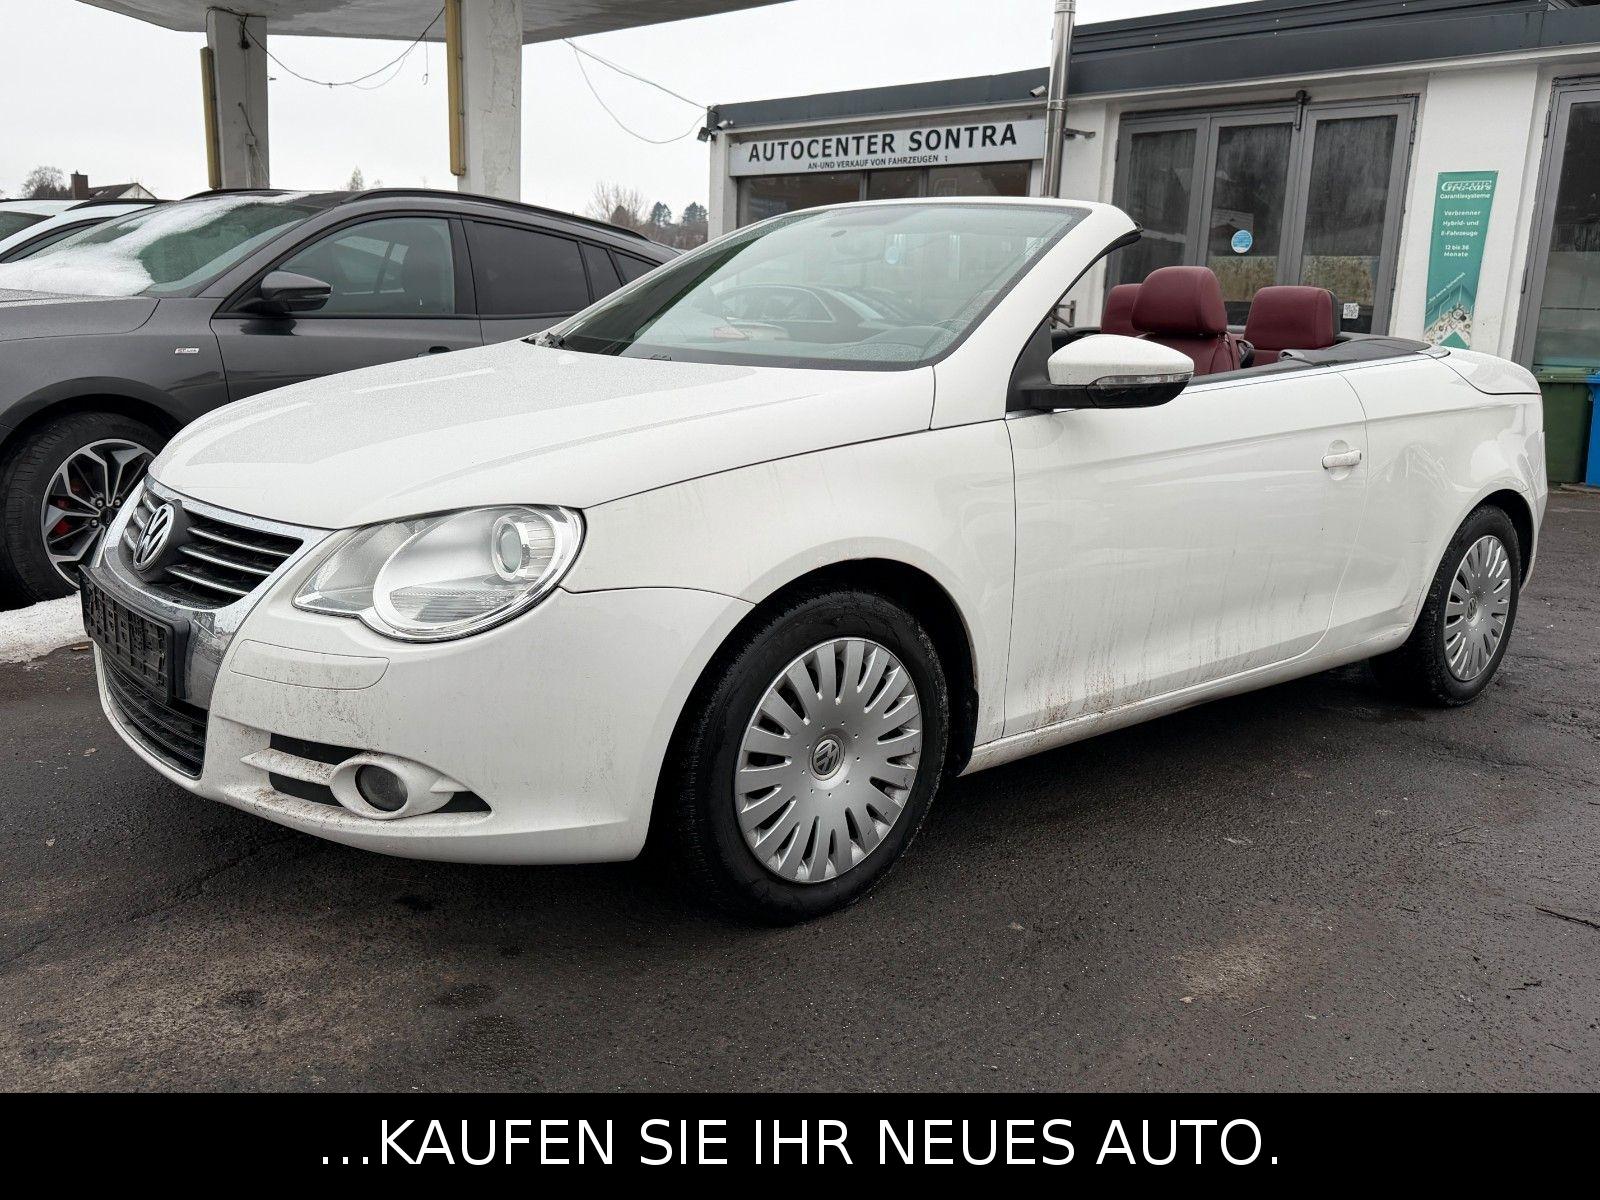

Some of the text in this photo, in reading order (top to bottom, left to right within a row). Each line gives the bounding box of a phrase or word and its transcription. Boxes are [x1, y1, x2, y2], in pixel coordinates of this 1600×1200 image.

[748, 123, 1017, 162] AUTOCENTER SONTRA
[807, 162, 835, 170] AN-UND
[837, 159, 869, 168] VERKAUF
[870, 158, 887, 166] VON
[888, 154, 939, 165] FAHRZEUGEN
[133, 504, 175, 571] VW
